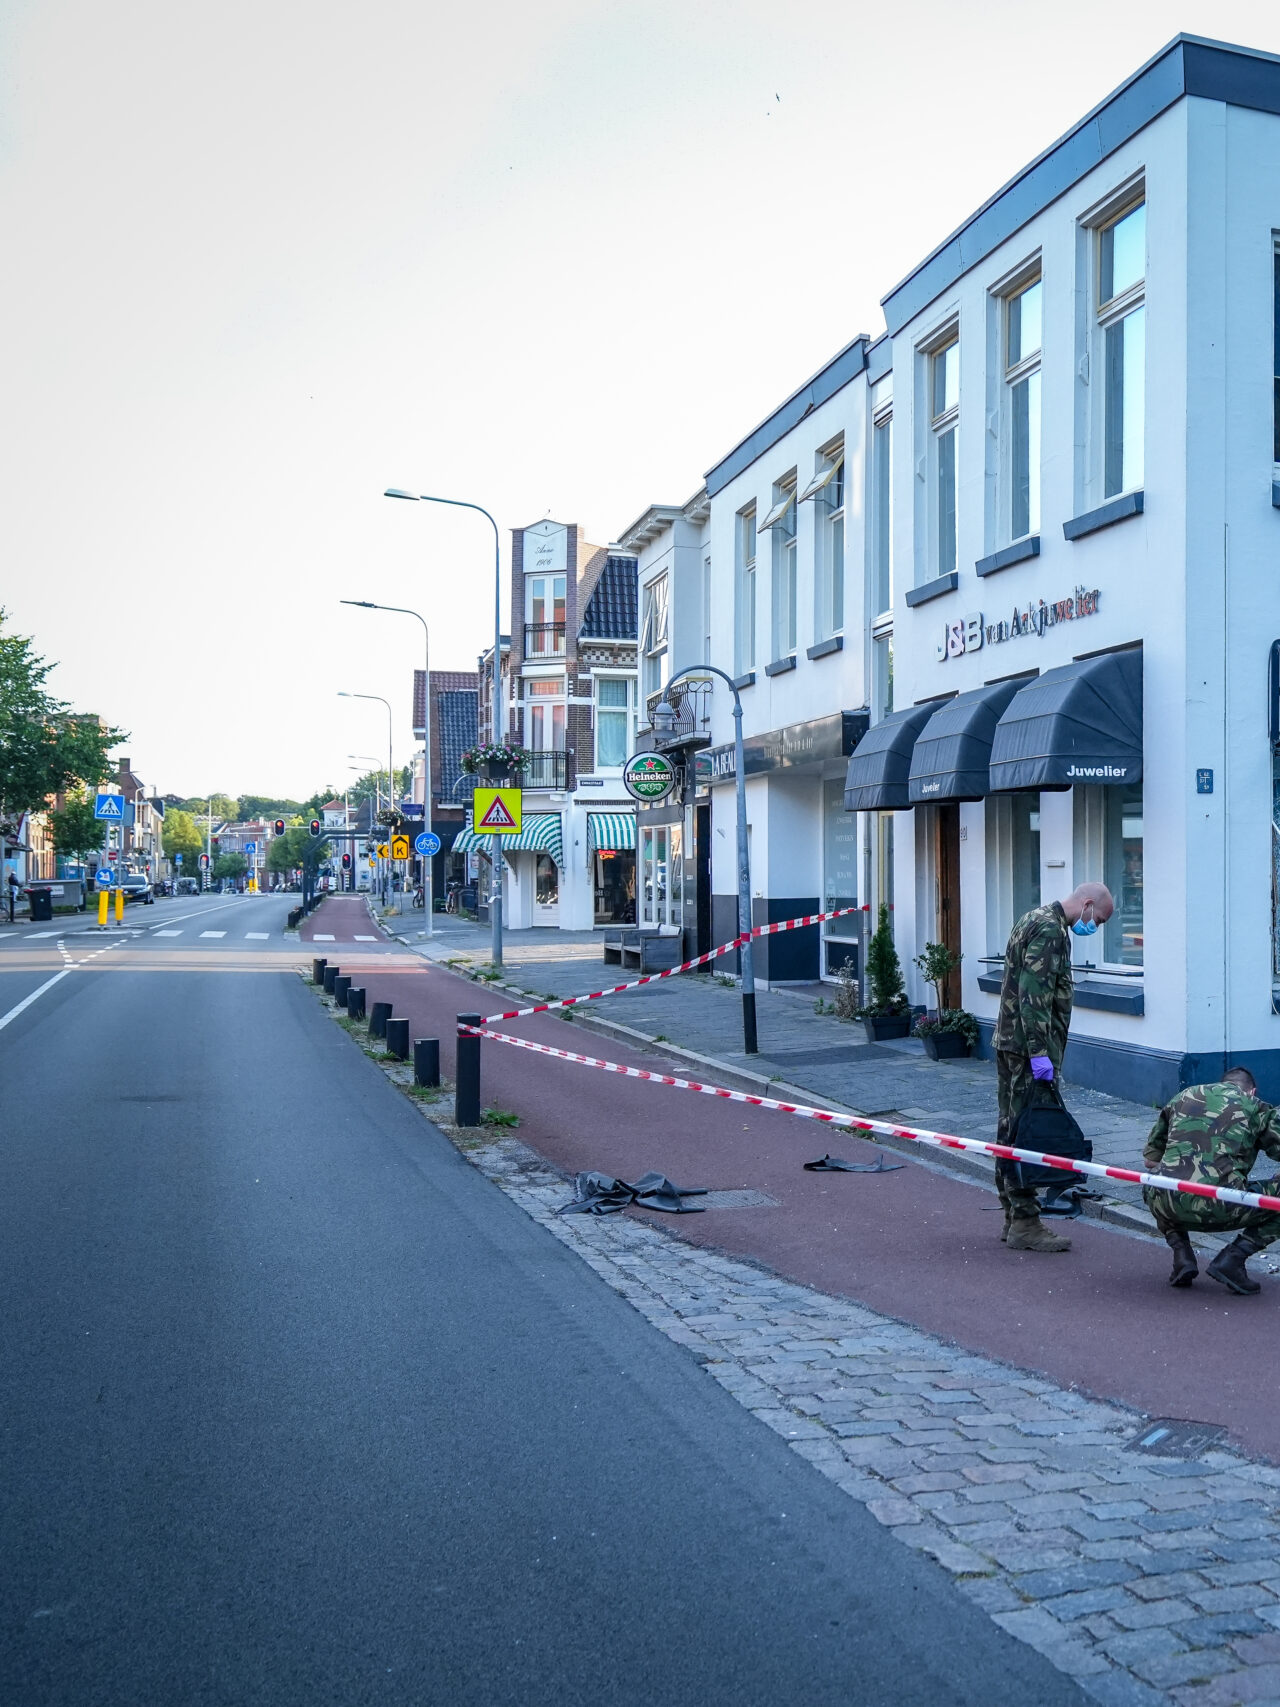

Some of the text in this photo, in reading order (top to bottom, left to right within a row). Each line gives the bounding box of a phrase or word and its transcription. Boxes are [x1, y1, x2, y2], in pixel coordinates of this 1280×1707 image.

[935, 585, 1101, 662] J&B van Ark juwelier
[1067, 765, 1127, 777] Juwelier
[628, 772, 672, 781] Heineken
[396, 847, 404, 856] K
